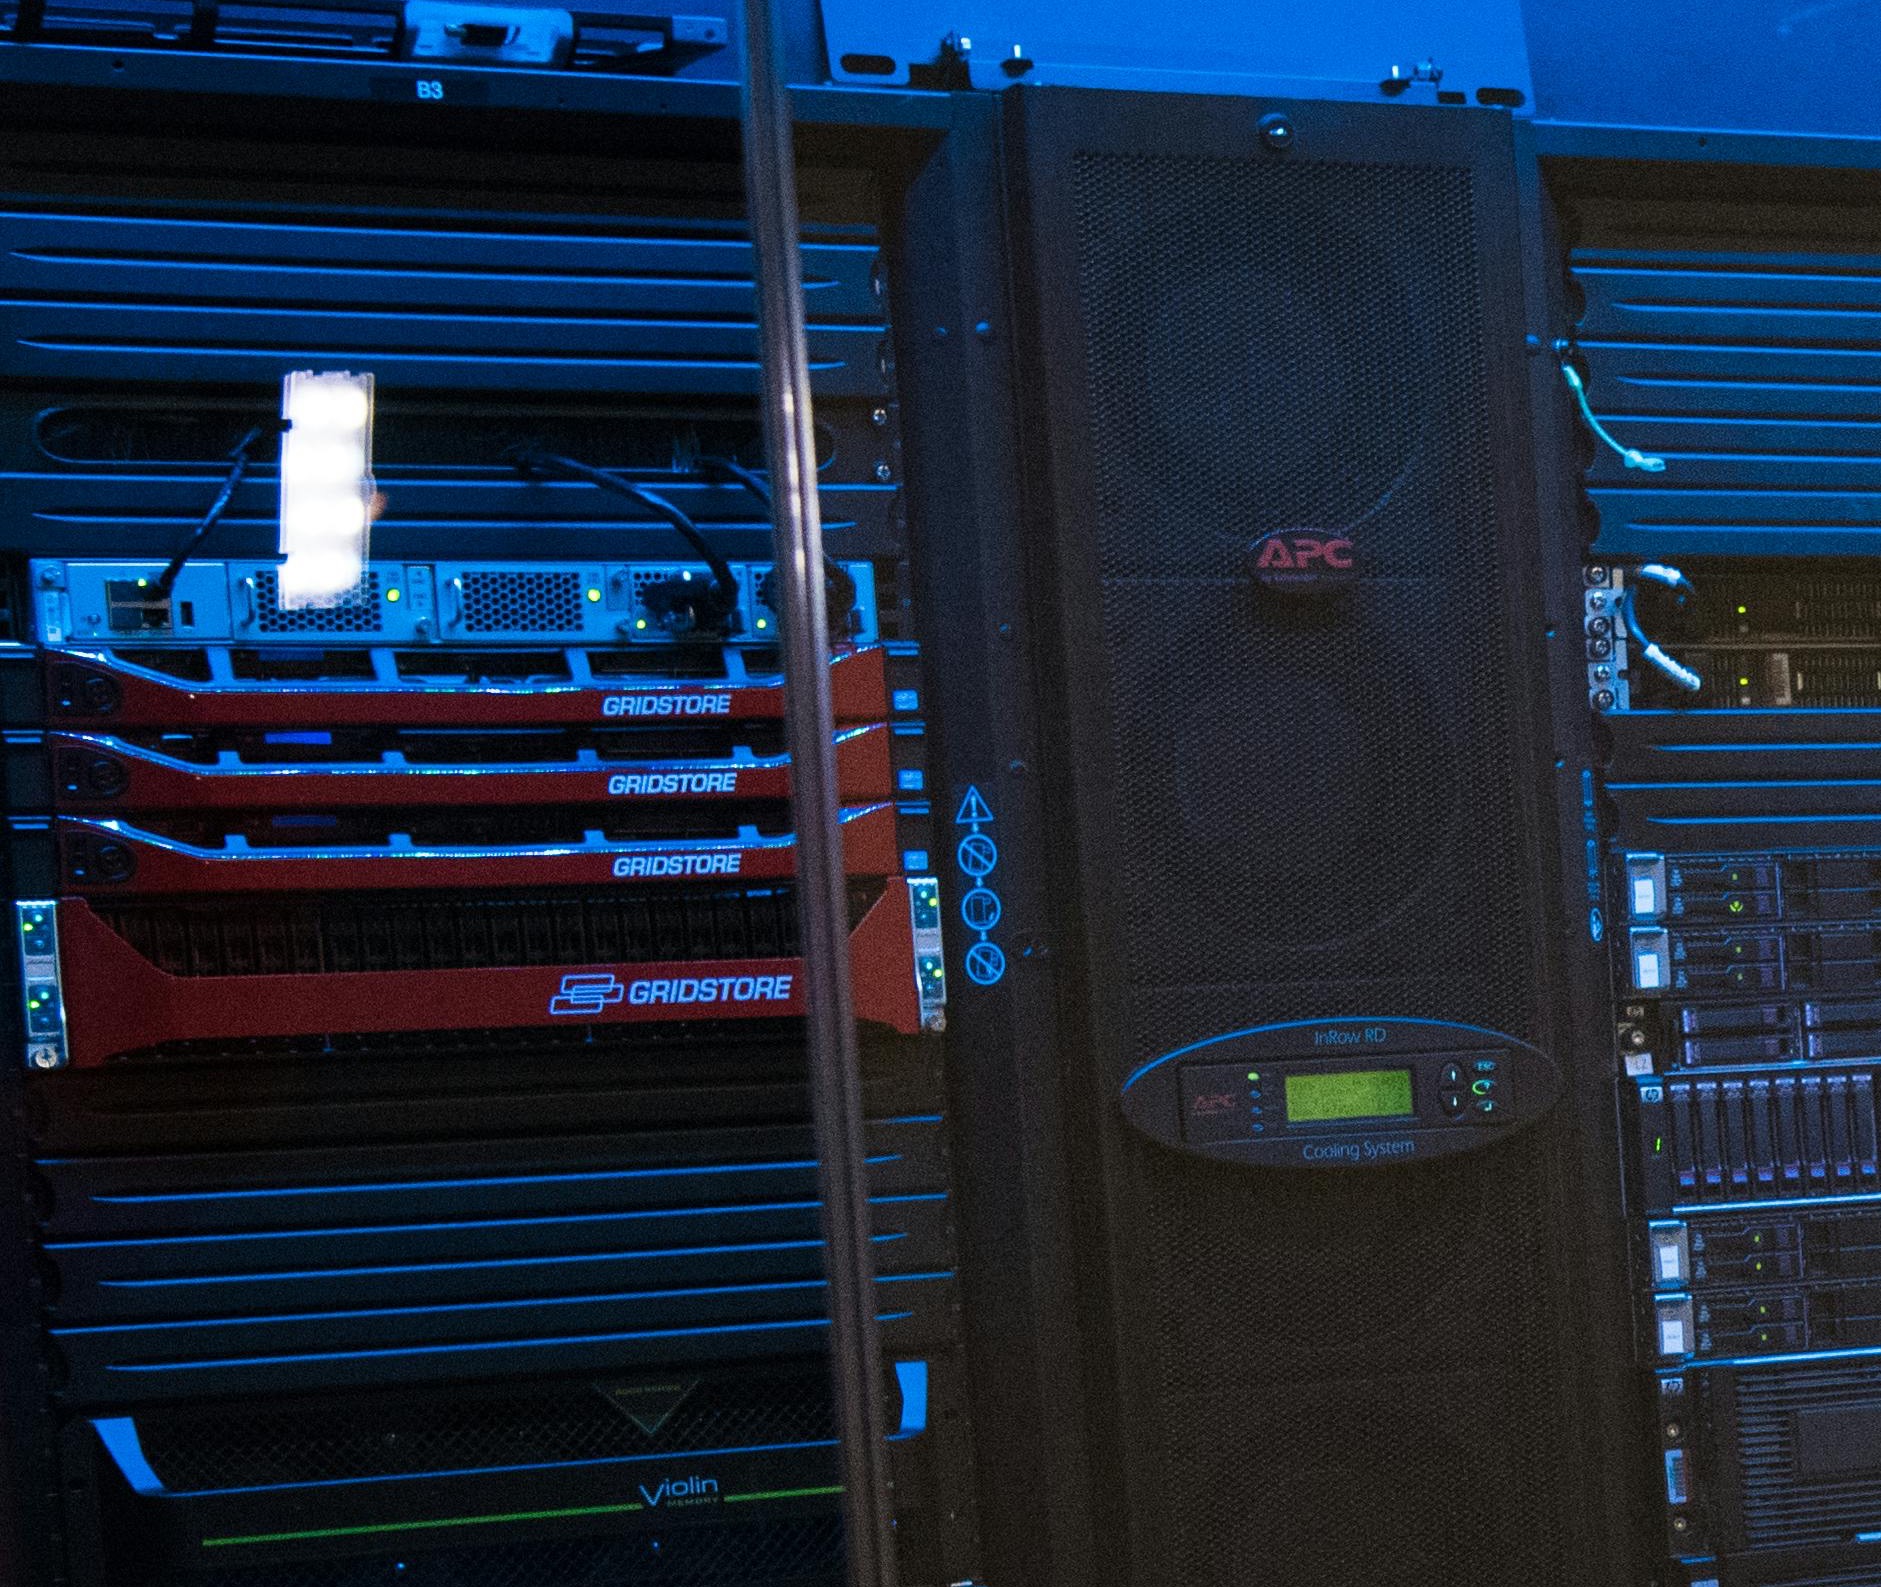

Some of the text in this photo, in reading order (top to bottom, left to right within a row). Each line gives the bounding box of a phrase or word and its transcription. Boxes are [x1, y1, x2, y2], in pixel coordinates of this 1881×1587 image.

[415, 79, 444, 100] B3
[1256, 538, 1354, 569] APC
[602, 693, 732, 716] GRIDSTORE
[608, 772, 738, 795] GRIDSTORE
[612, 853, 742, 877] GRIDSTORE
[628, 975, 794, 1005] GRIDSTORE
[1314, 1027, 1387, 1046] InRow RD
[1302, 1138, 1416, 1162] Cooling System
[638, 1475, 720, 1507] Violin
